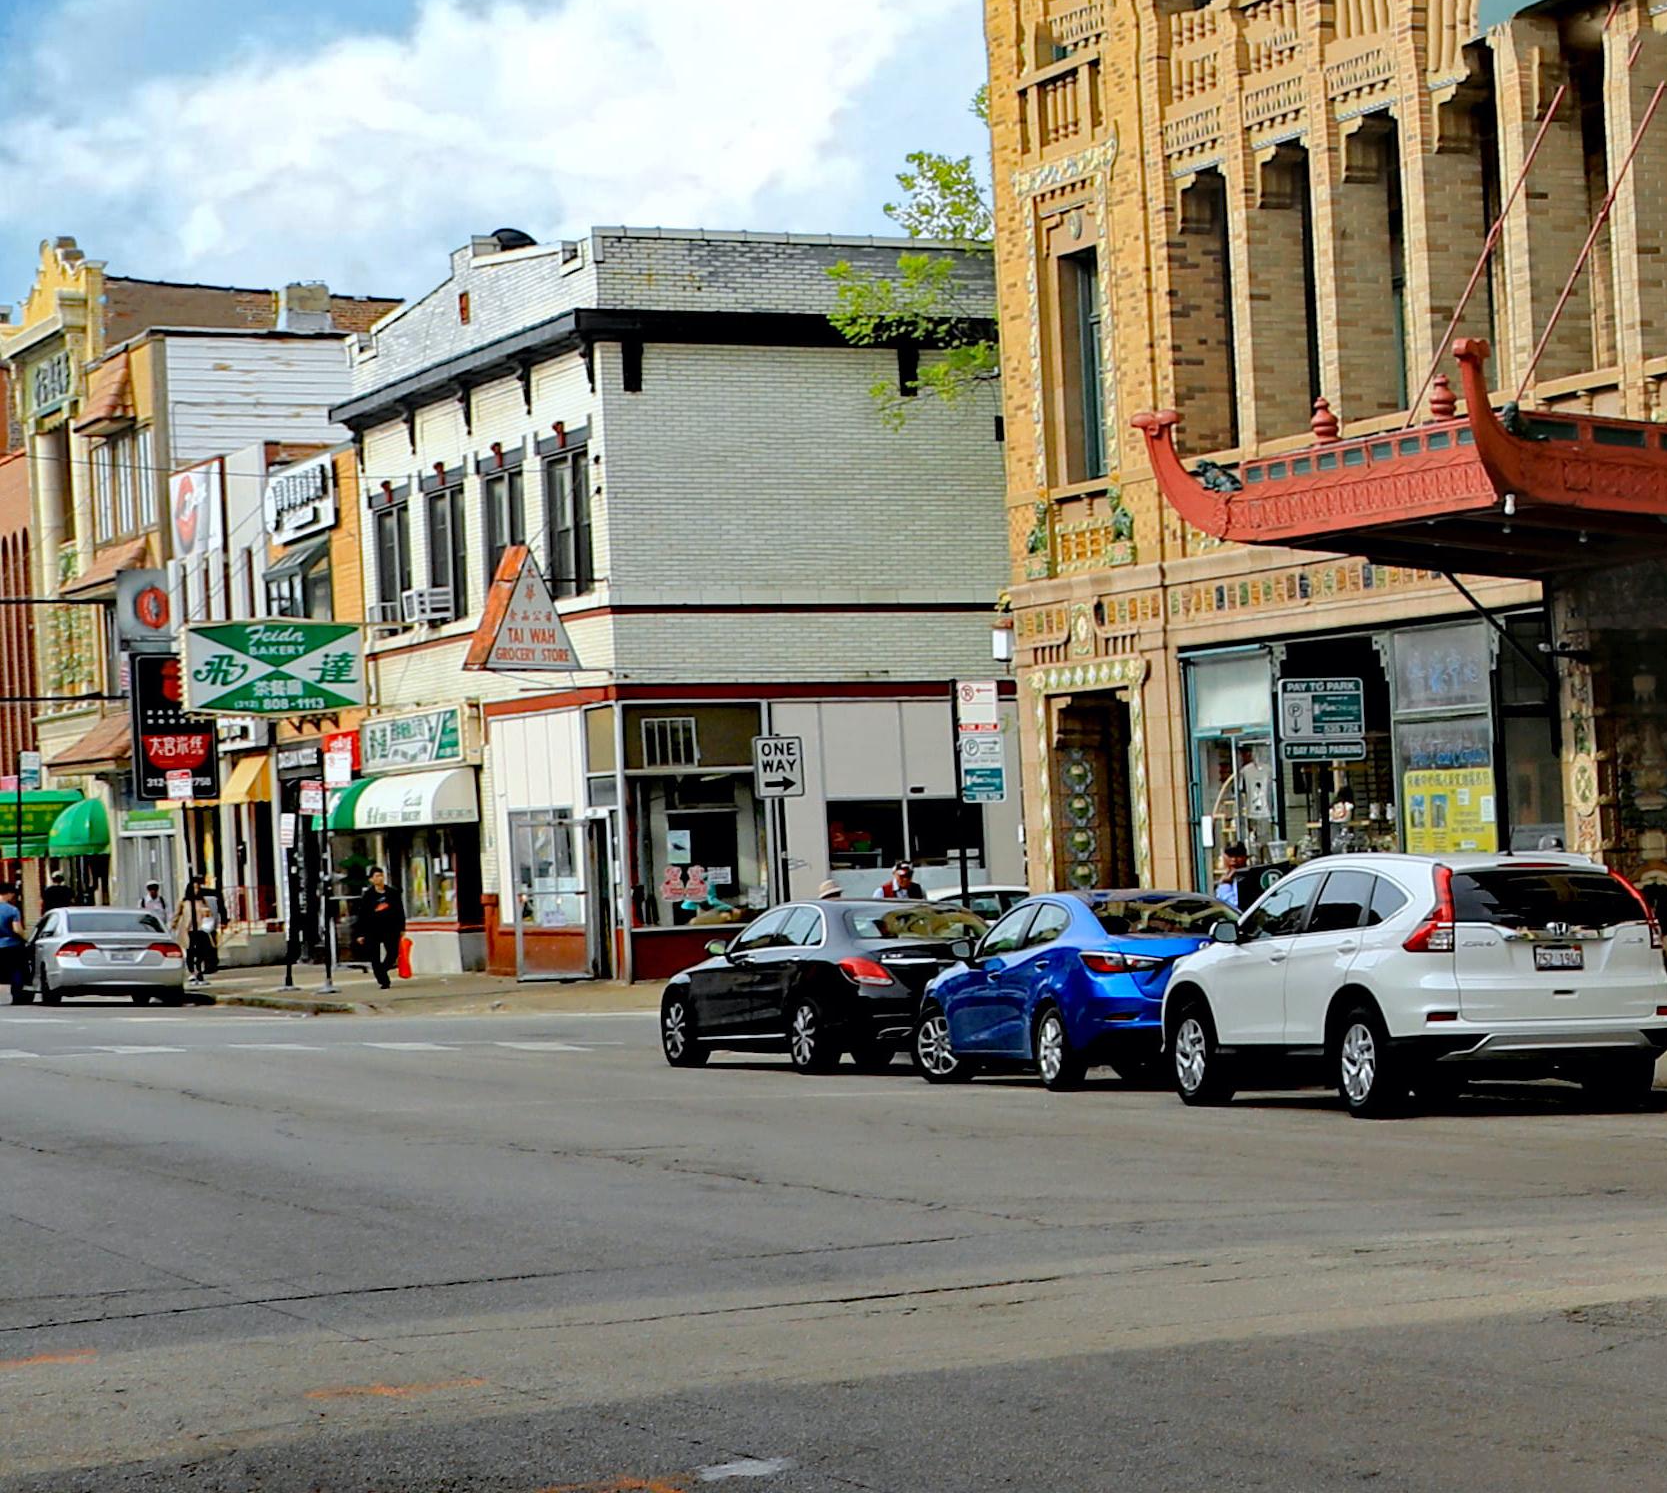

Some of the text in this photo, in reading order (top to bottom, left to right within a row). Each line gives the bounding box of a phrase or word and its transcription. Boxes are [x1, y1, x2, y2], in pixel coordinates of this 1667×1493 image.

[507, 628, 556, 644] TAI WAH
[249, 645, 305, 656] BAKERY
[495, 647, 570, 662] GROCERY STORE
[1286, 681, 1356, 692] PAY TO PARK
[761, 742, 796, 757] ONE
[762, 760, 797, 774] WAY
